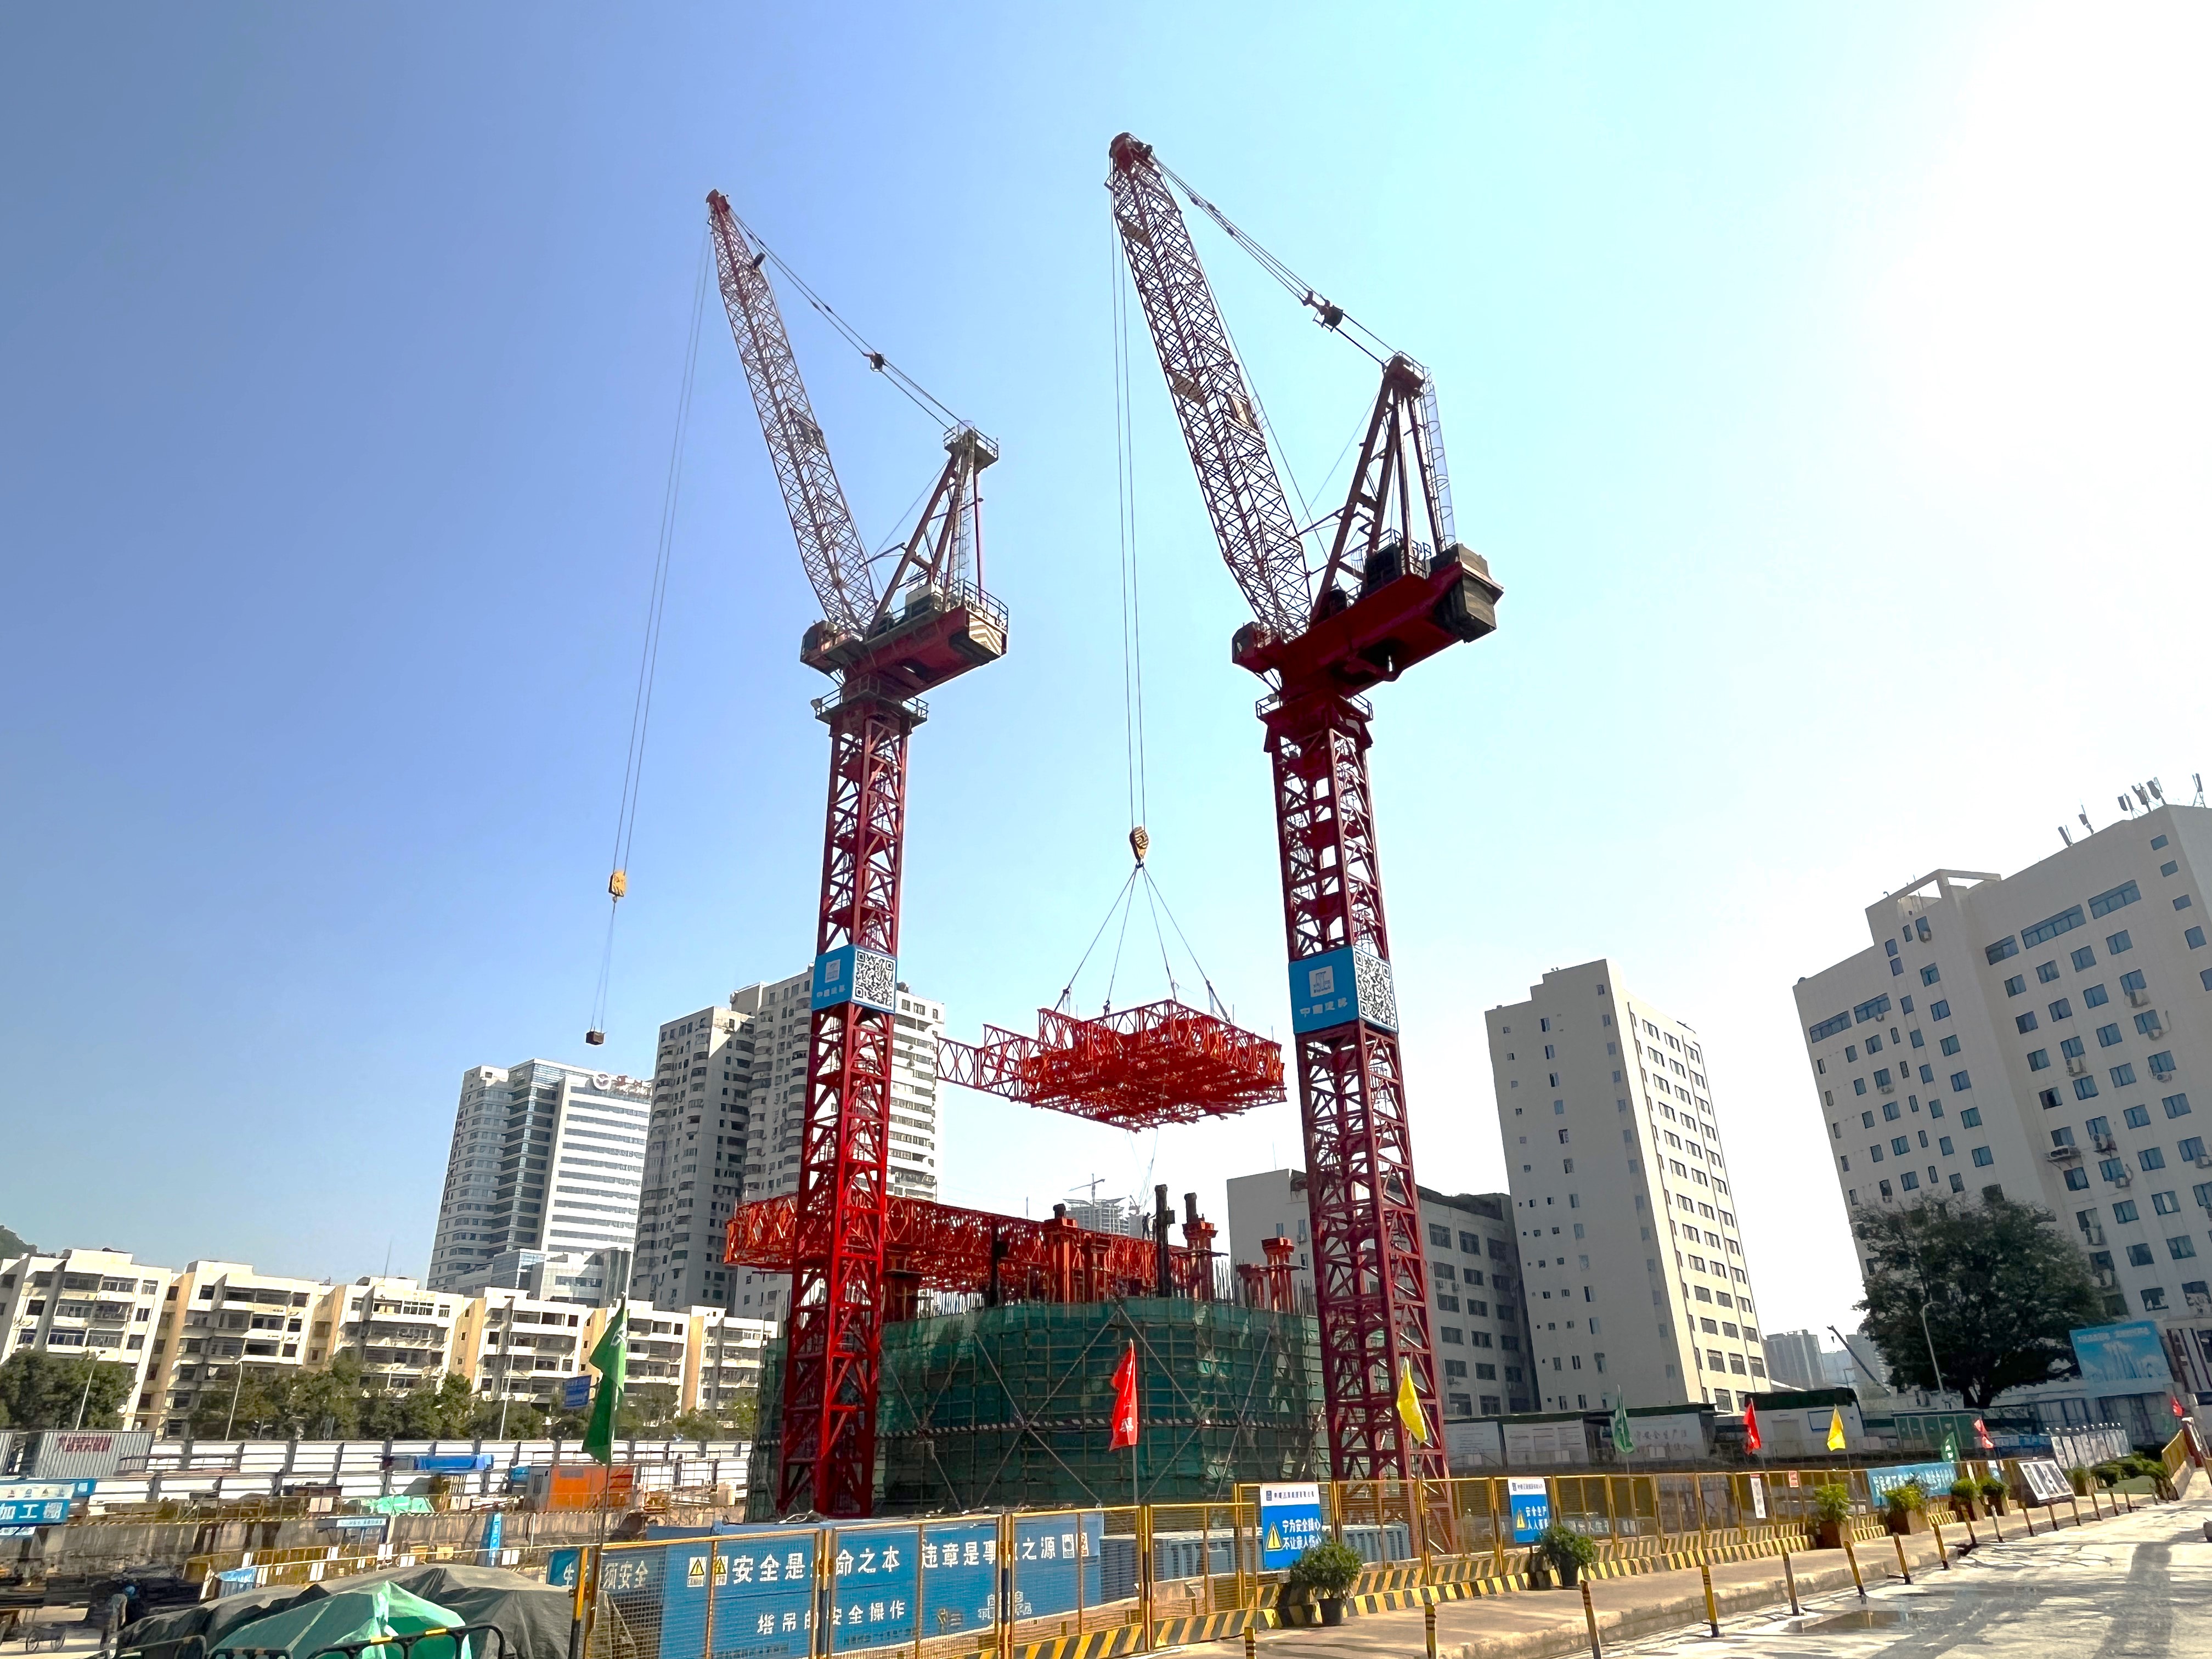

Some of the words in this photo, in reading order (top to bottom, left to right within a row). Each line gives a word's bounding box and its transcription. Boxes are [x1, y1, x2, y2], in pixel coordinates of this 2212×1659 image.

[732, 1545, 900, 1584] 安全是命之本
[922, 1537, 1056, 1569] 违章是事之源
